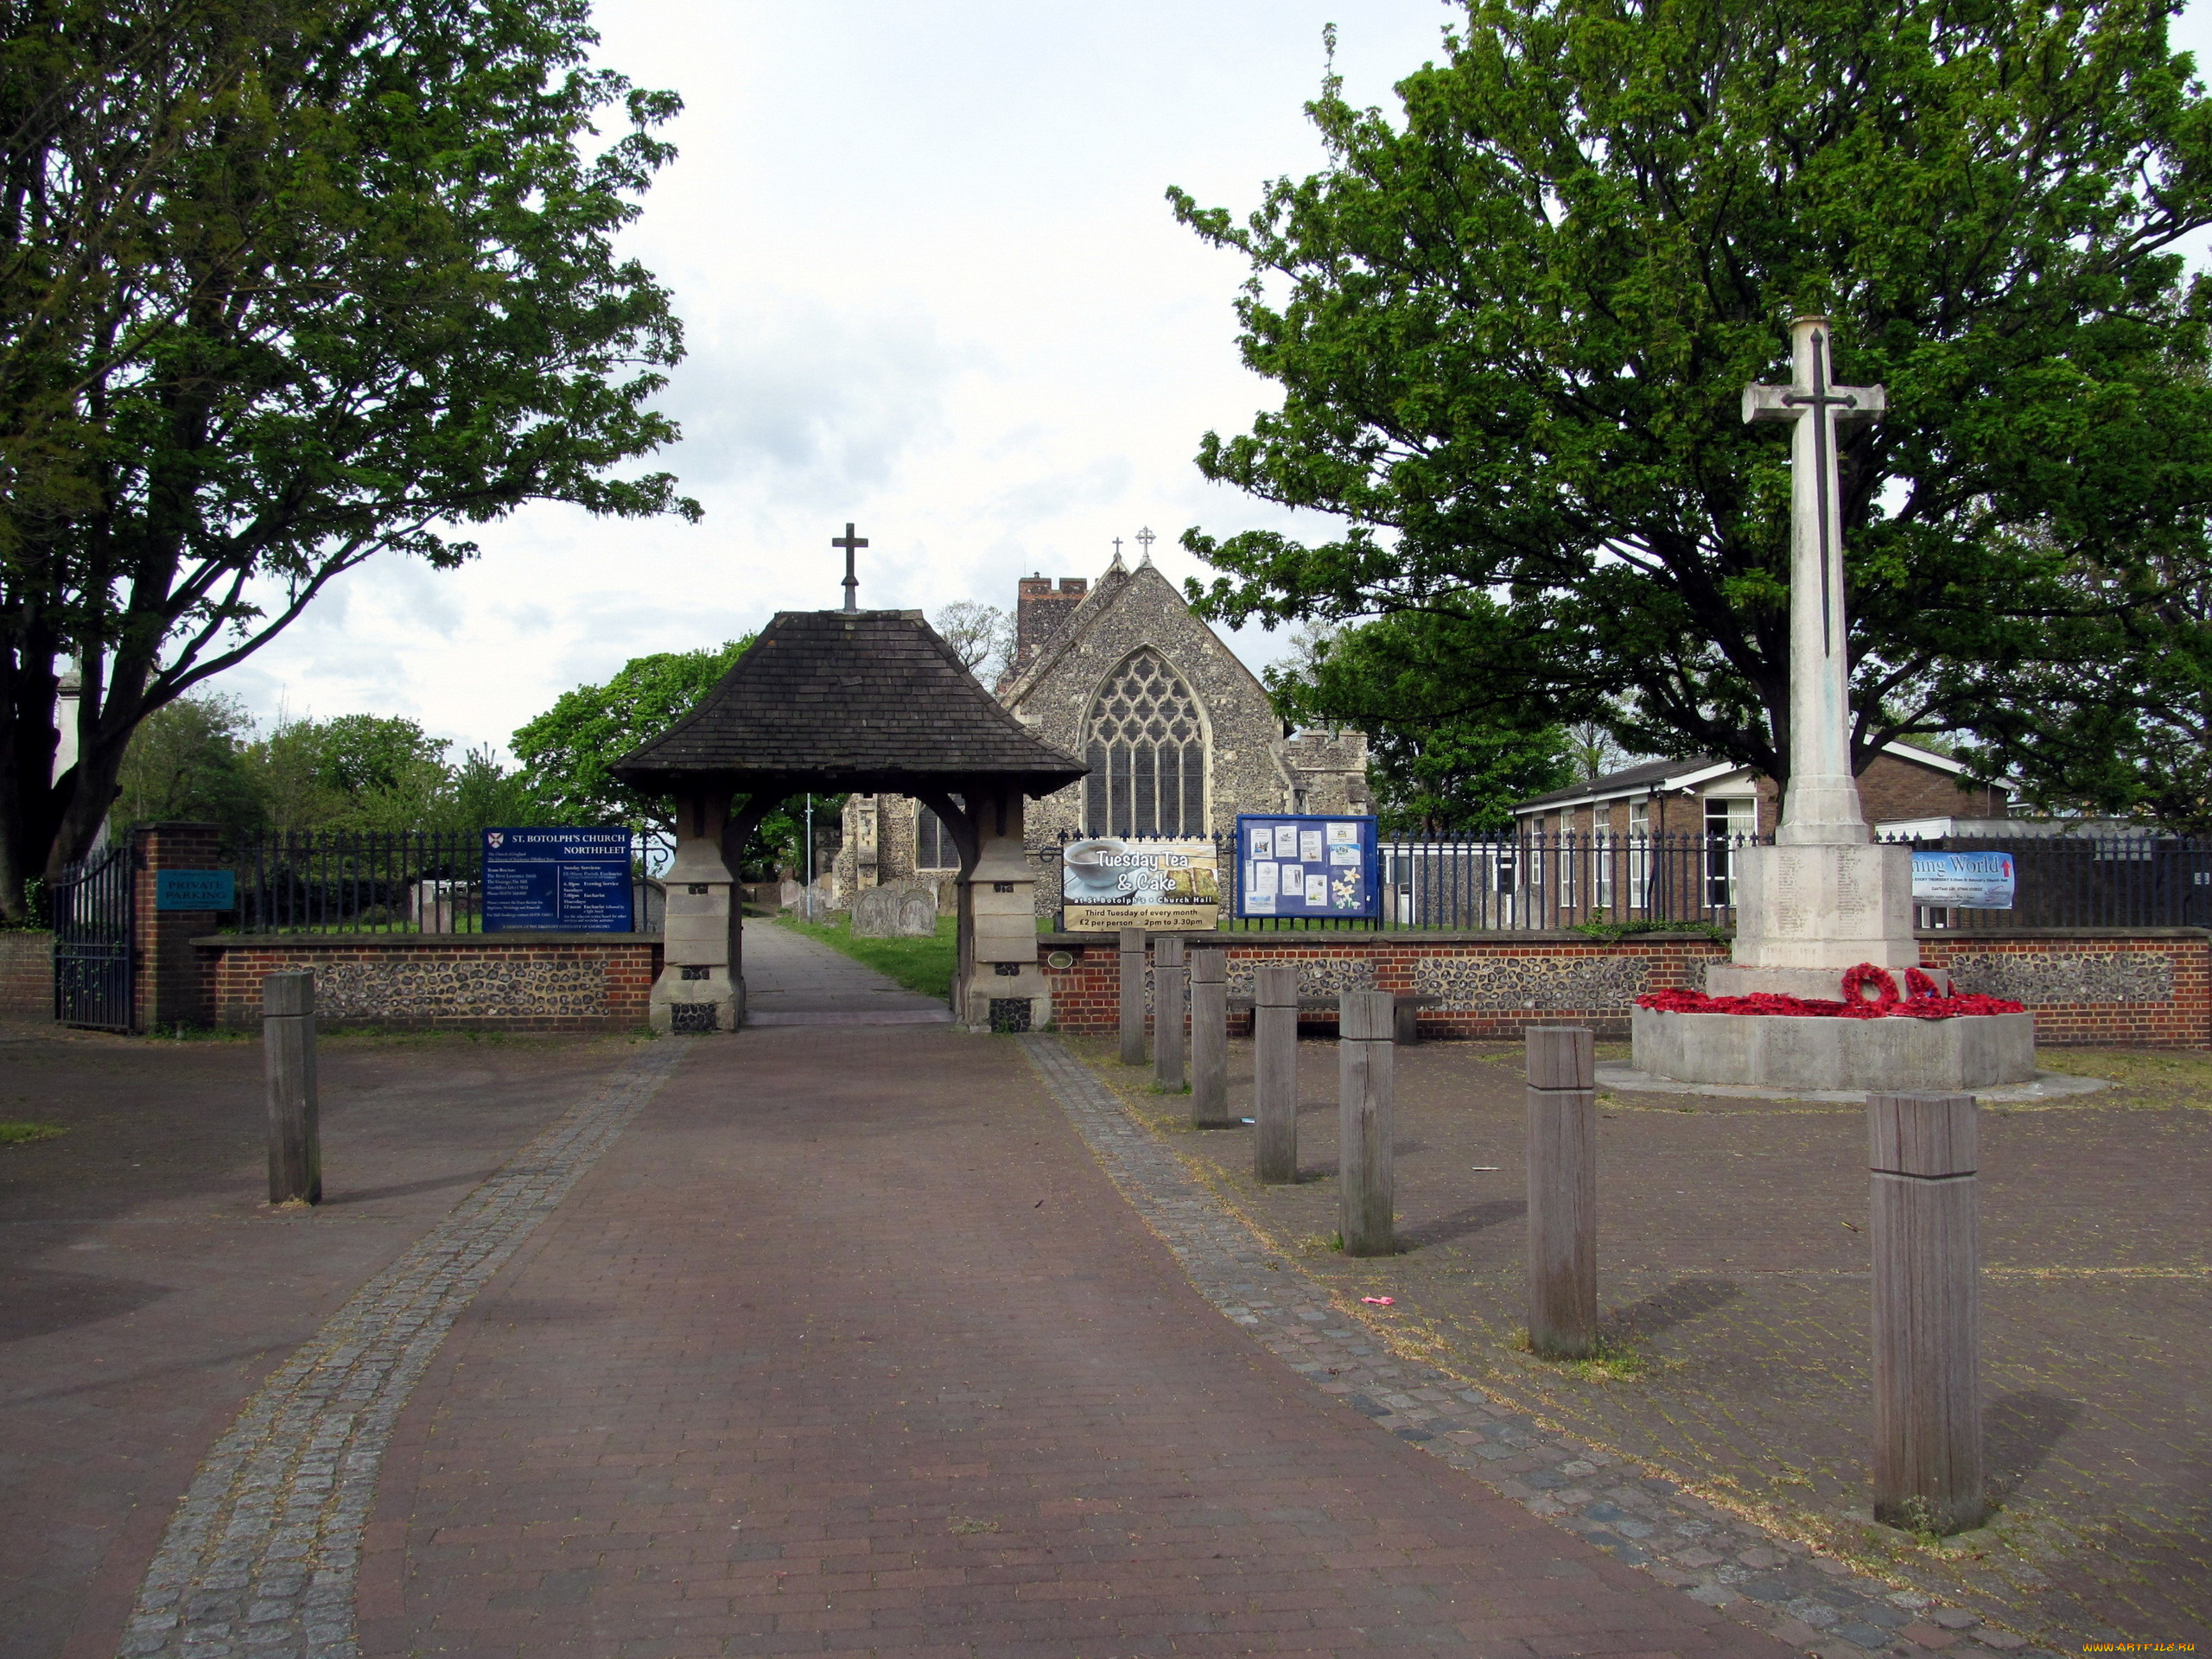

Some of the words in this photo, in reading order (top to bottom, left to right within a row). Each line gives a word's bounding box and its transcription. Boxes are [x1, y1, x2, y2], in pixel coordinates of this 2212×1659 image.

[1096, 850, 1159, 871] Tuesday
[1161, 850, 1188, 867] Tea
[1949, 856, 1999, 873] World
[1117, 873, 1132, 890] &
[1136, 873, 1176, 890] Cake
